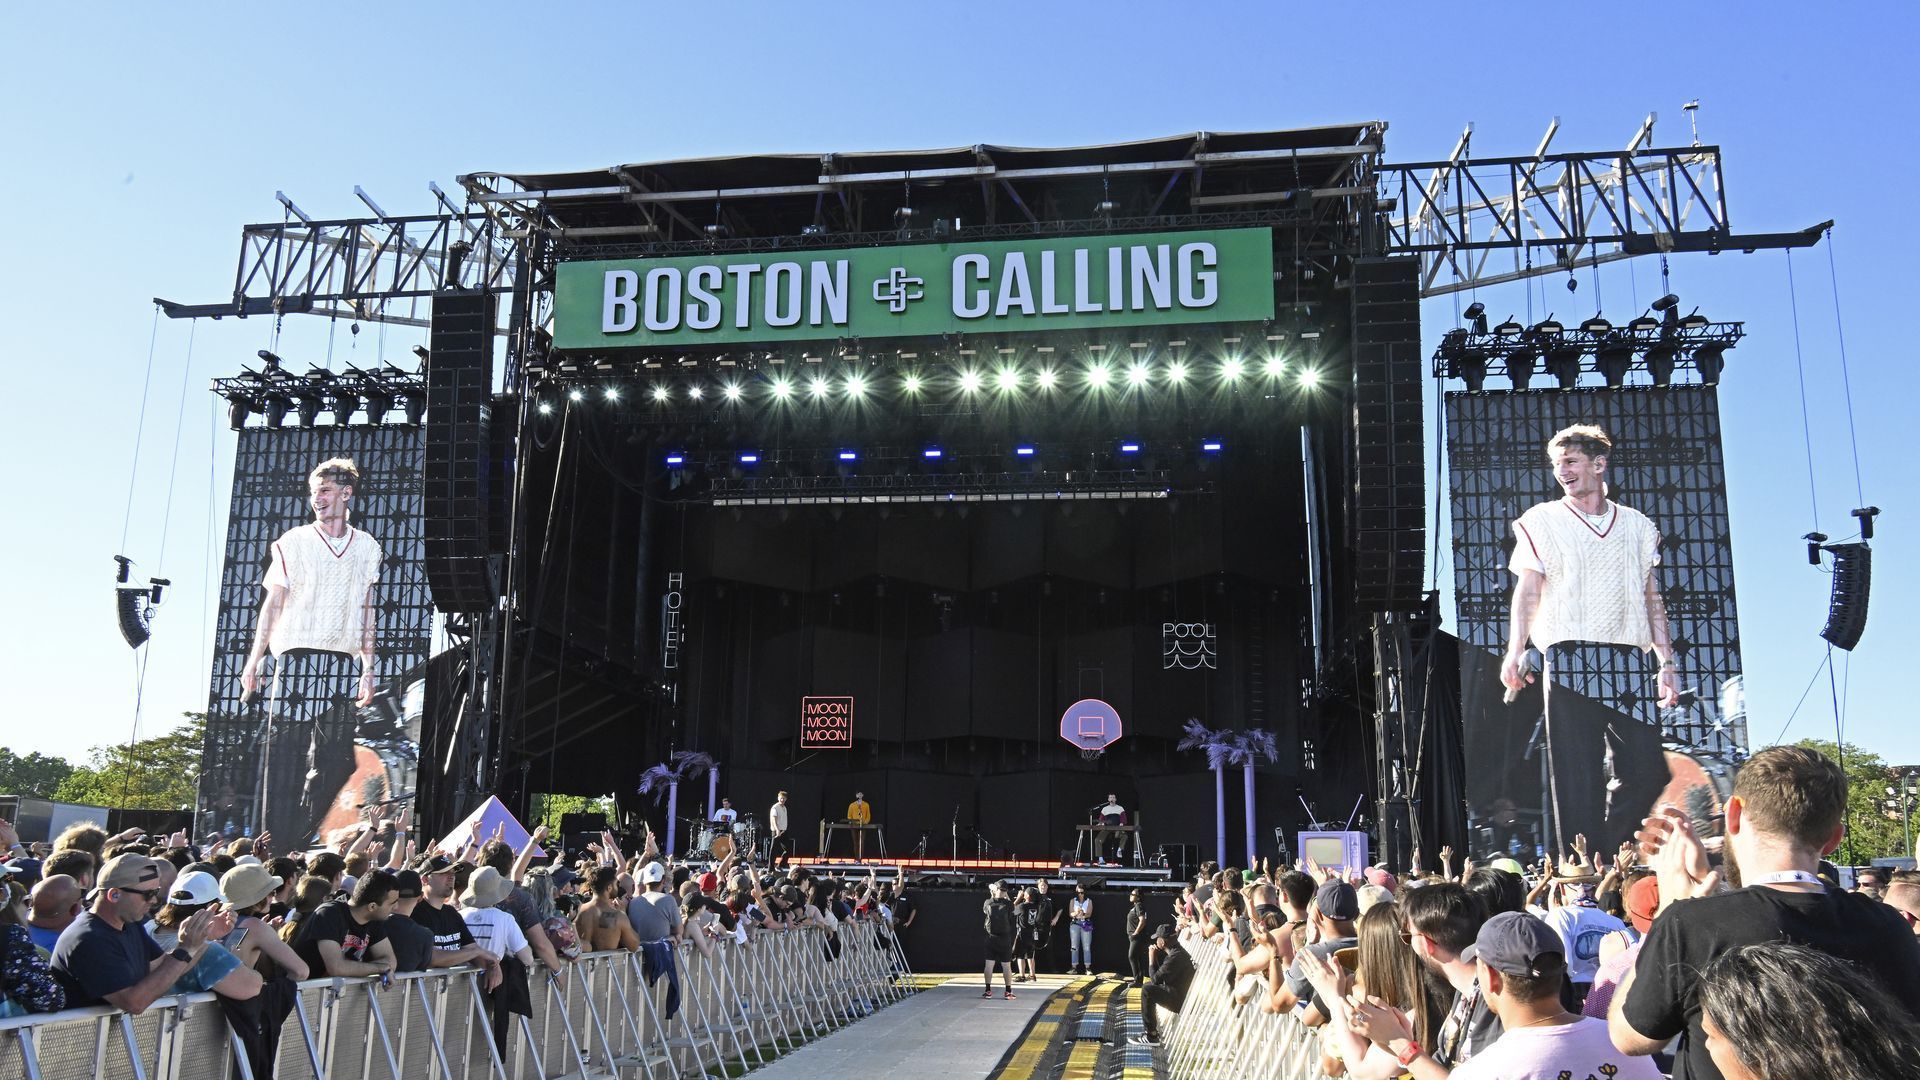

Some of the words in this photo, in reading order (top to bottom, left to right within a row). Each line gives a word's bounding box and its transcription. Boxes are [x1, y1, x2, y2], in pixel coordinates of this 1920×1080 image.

[601, 259, 849, 335] BOSTON
[951, 241, 1218, 320] CALLING
[664, 572, 683, 668] HOTEL
[1162, 622, 1217, 638] POOL
[807, 703, 848, 714] MOON
[807, 716, 847, 728] MOON
[807, 729, 847, 741] MOON
